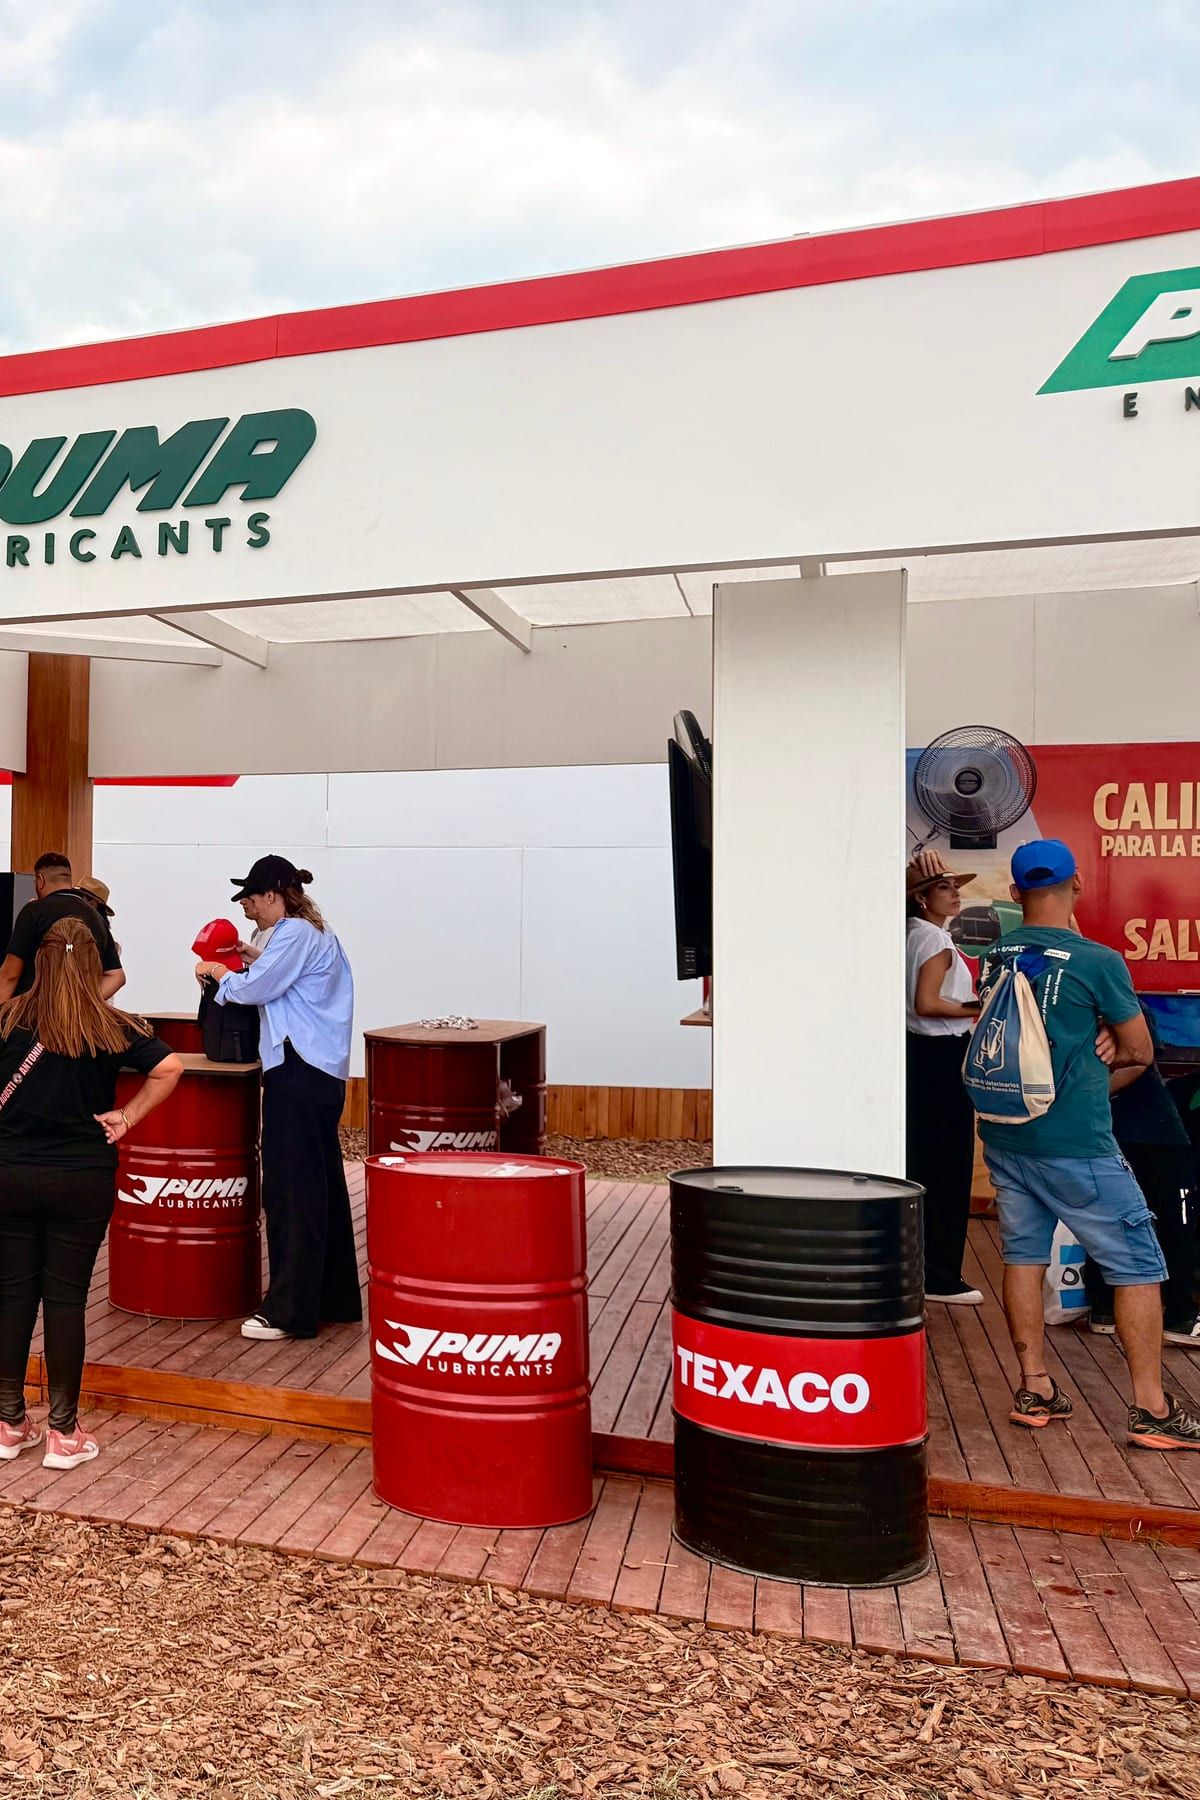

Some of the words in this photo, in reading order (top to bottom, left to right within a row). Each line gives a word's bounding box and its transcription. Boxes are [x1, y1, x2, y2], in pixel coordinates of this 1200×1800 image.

[1093, 782, 1200, 830] CALI
[1101, 835, 1156, 857] PARA
[1160, 835, 1186, 857] LA
[431, 1130, 497, 1148] PUMA
[160, 1176, 248, 1199] PUMA
[158, 1198, 243, 1209] LUBRICANTS
[431, 1331, 562, 1363] PUMA
[426, 1358, 554, 1377] LUBRICANTS
[677, 1344, 870, 1414] TEXACO
